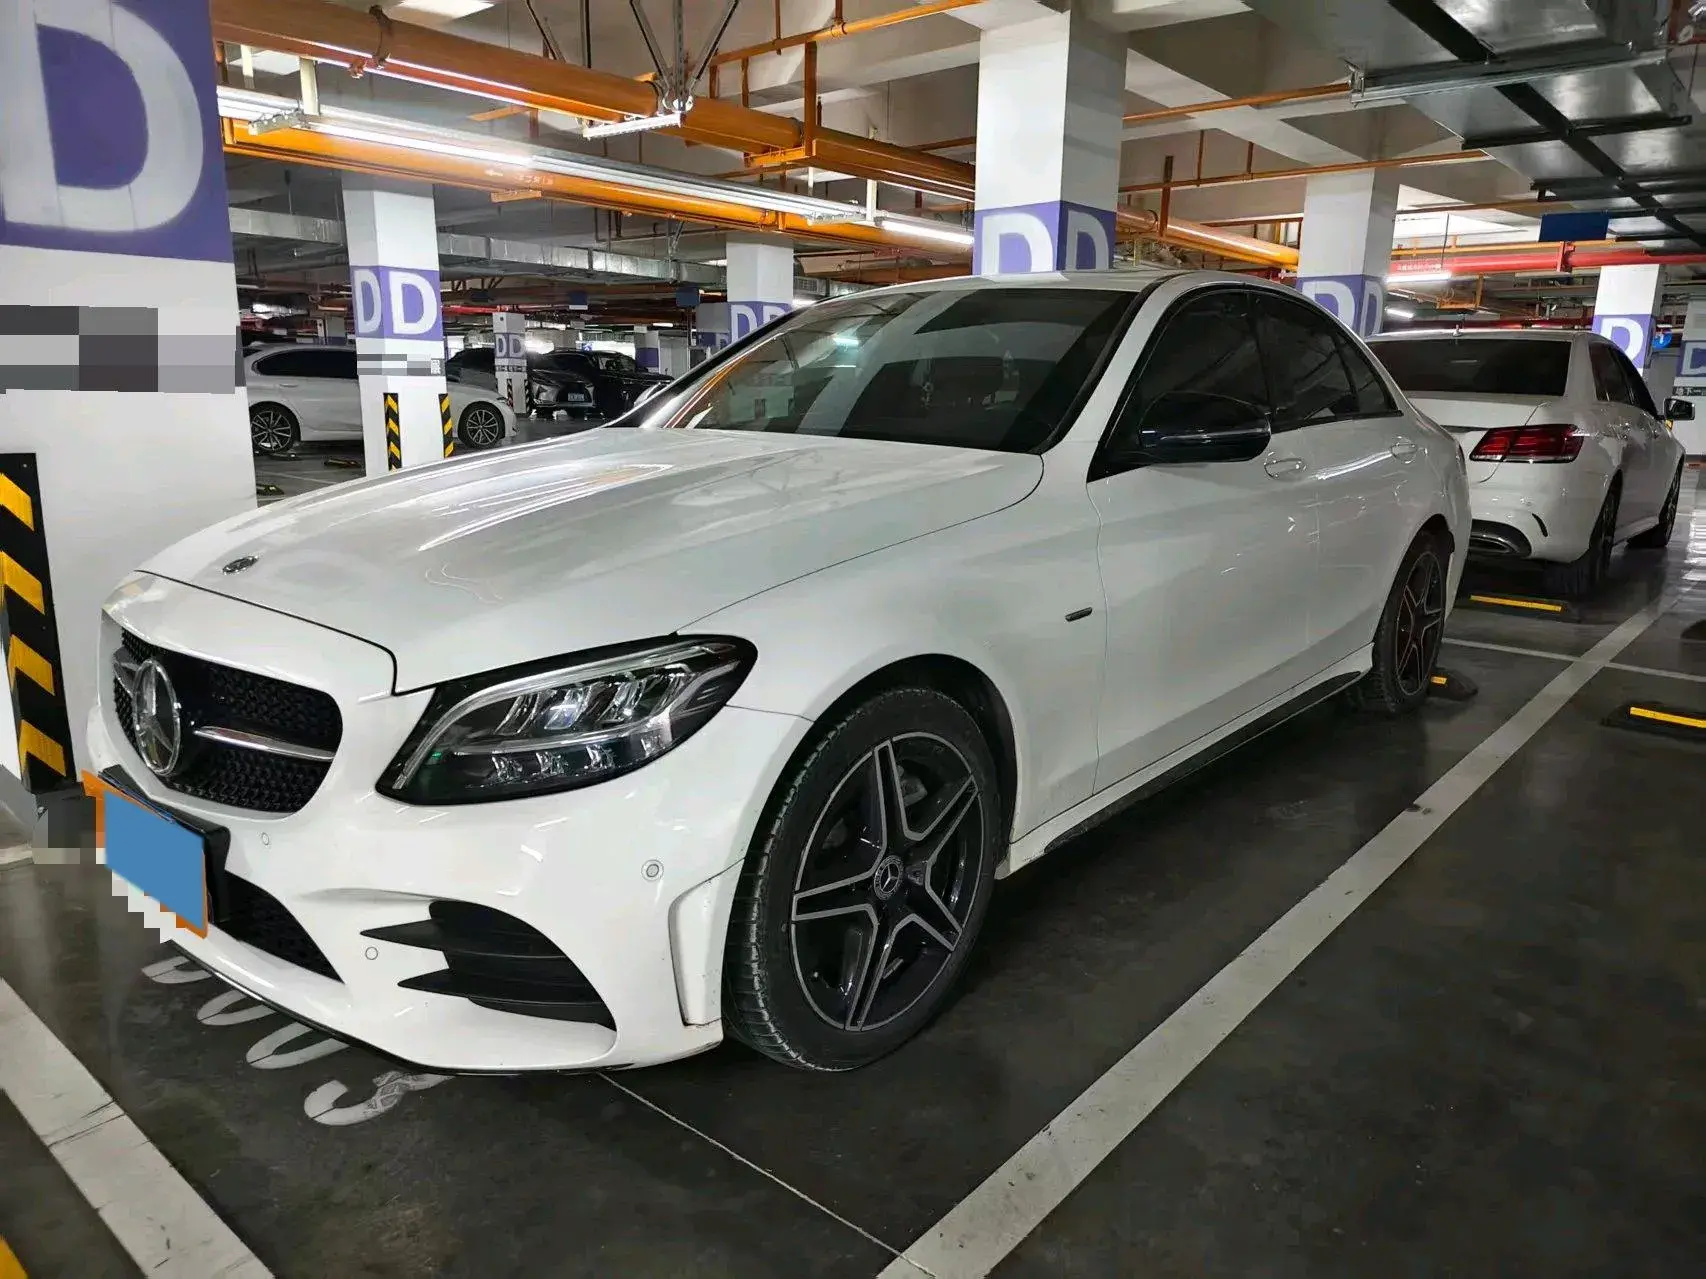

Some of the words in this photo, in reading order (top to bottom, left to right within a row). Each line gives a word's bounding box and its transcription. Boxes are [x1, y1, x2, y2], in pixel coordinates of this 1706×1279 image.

[0, 0, 204, 232] D
[981, 212, 1053, 276] D
[1065, 210, 1109, 272] D
[354, 269, 382, 333] D
[389, 271, 438, 335] D
[495, 334, 507, 357] D
[509, 334, 525, 357] D
